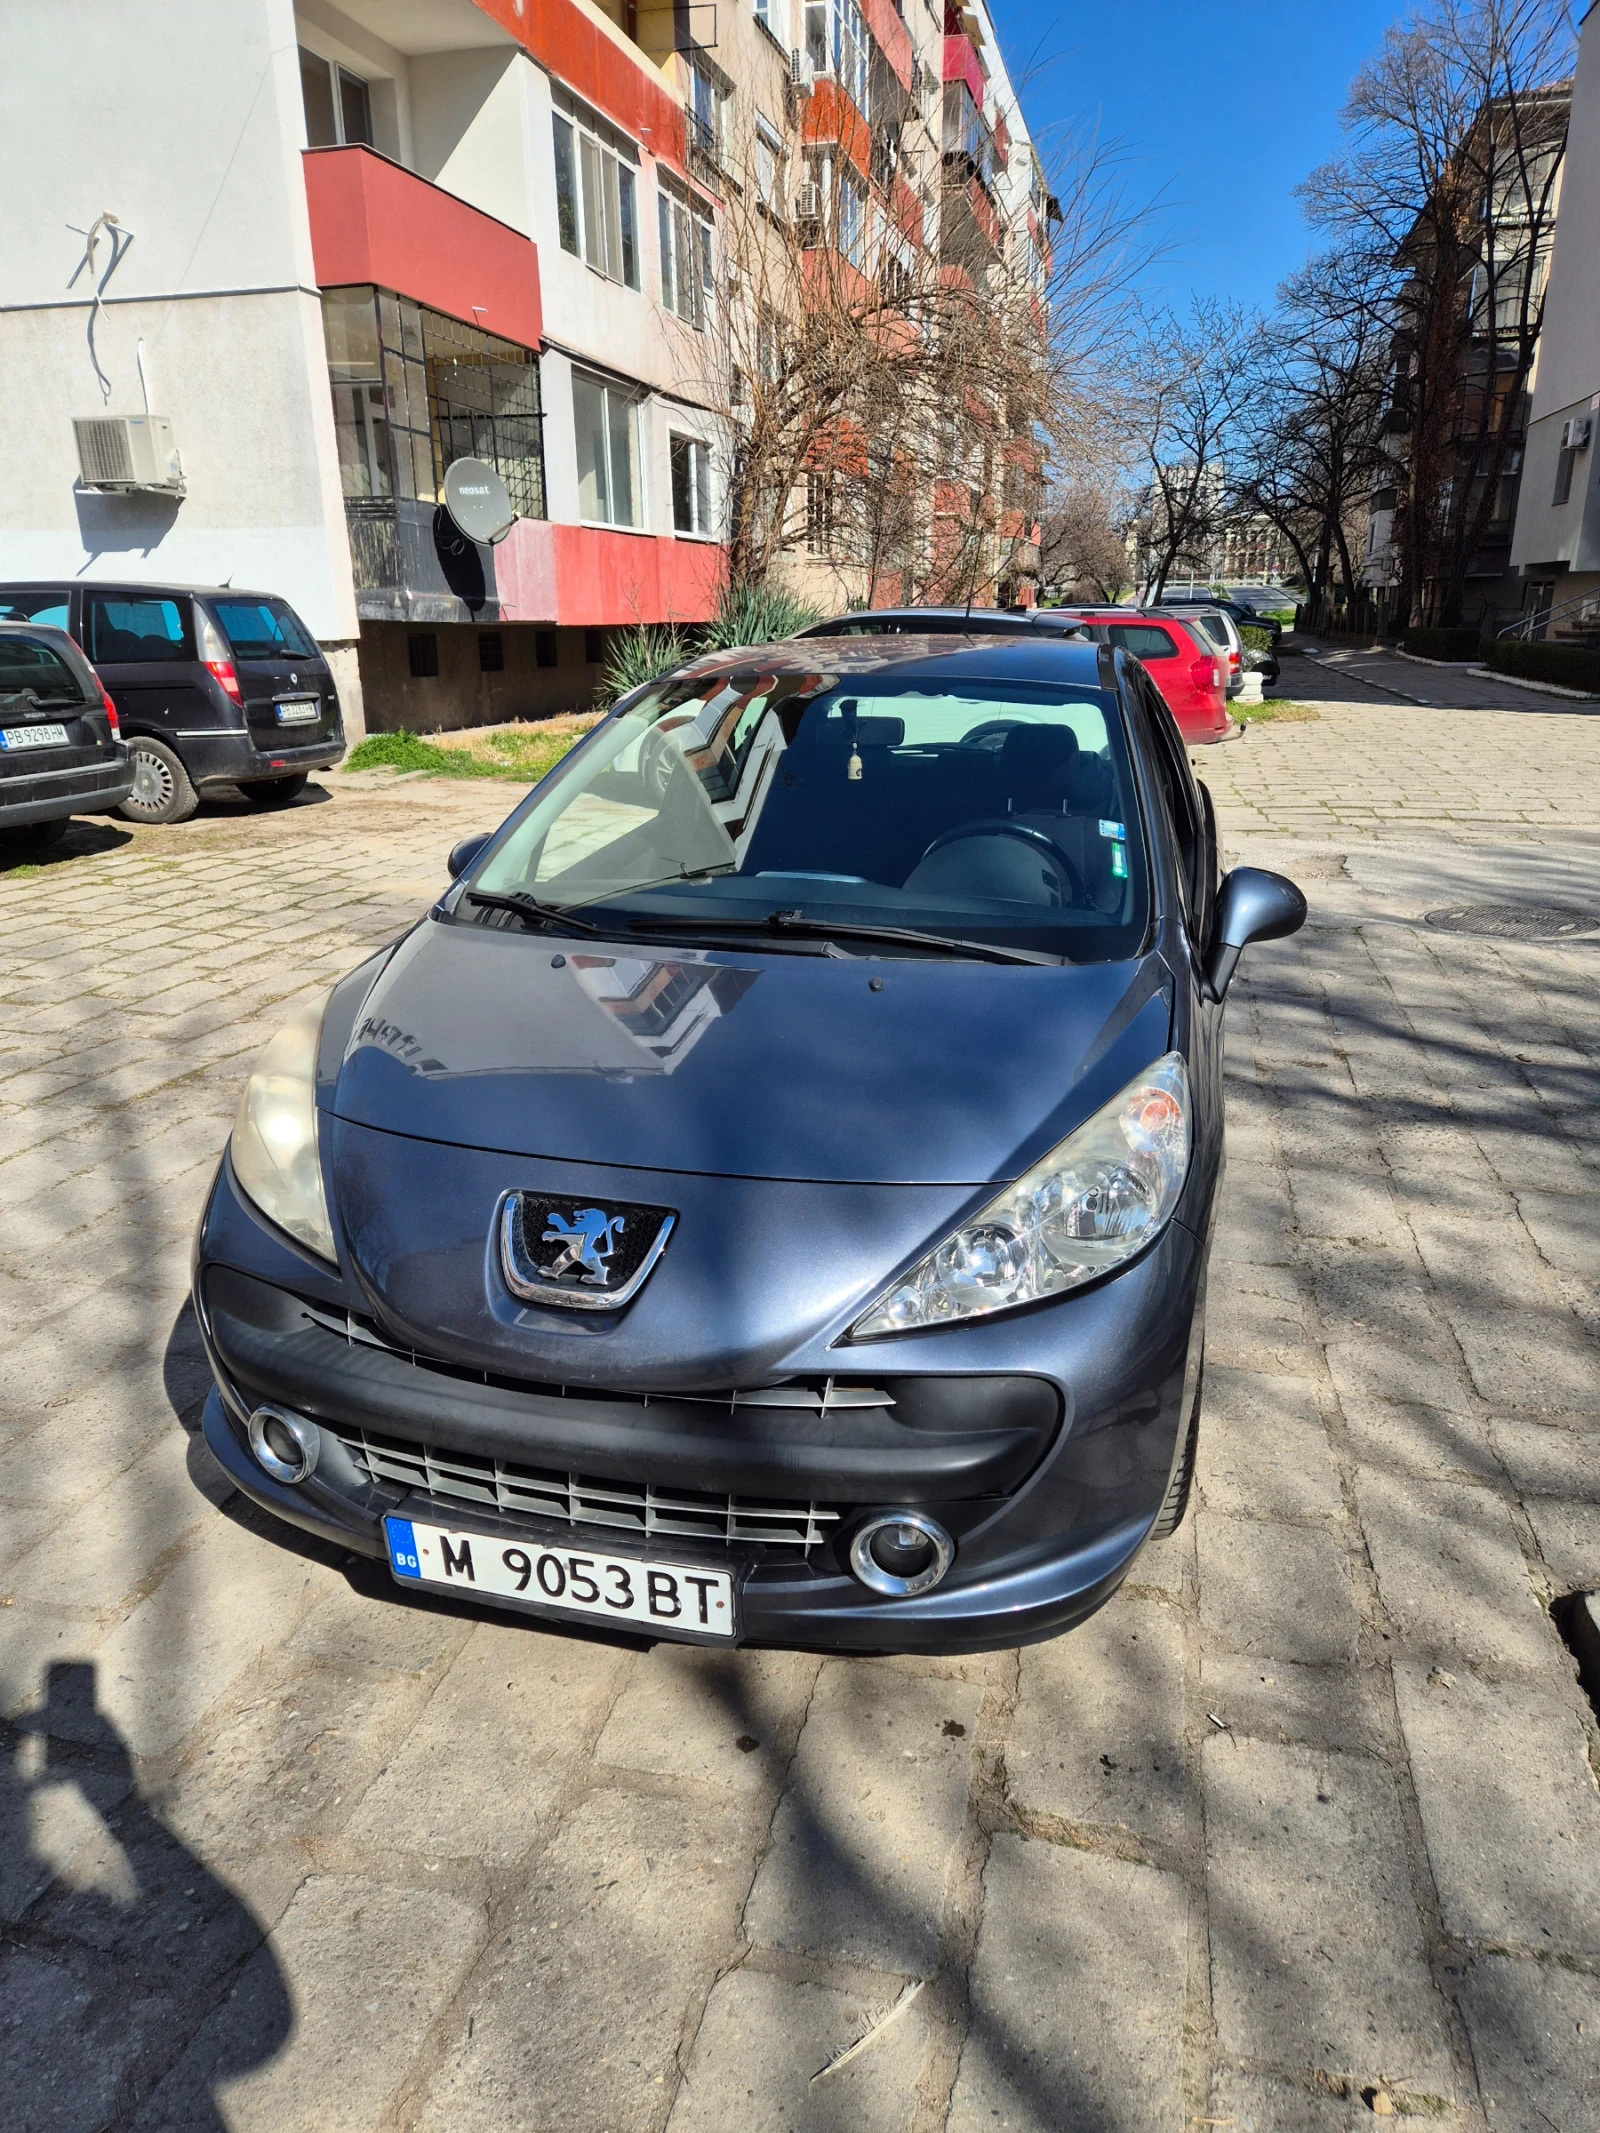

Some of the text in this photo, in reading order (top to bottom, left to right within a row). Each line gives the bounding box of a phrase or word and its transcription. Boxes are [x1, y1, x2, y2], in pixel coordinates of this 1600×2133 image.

[459, 485, 490, 495] neosat
[6, 730, 24, 745] PB
[24, 727, 51, 742] 9298
[396, 1552, 417, 1568] BG
[439, 1535, 720, 1624] M 9053 BT
